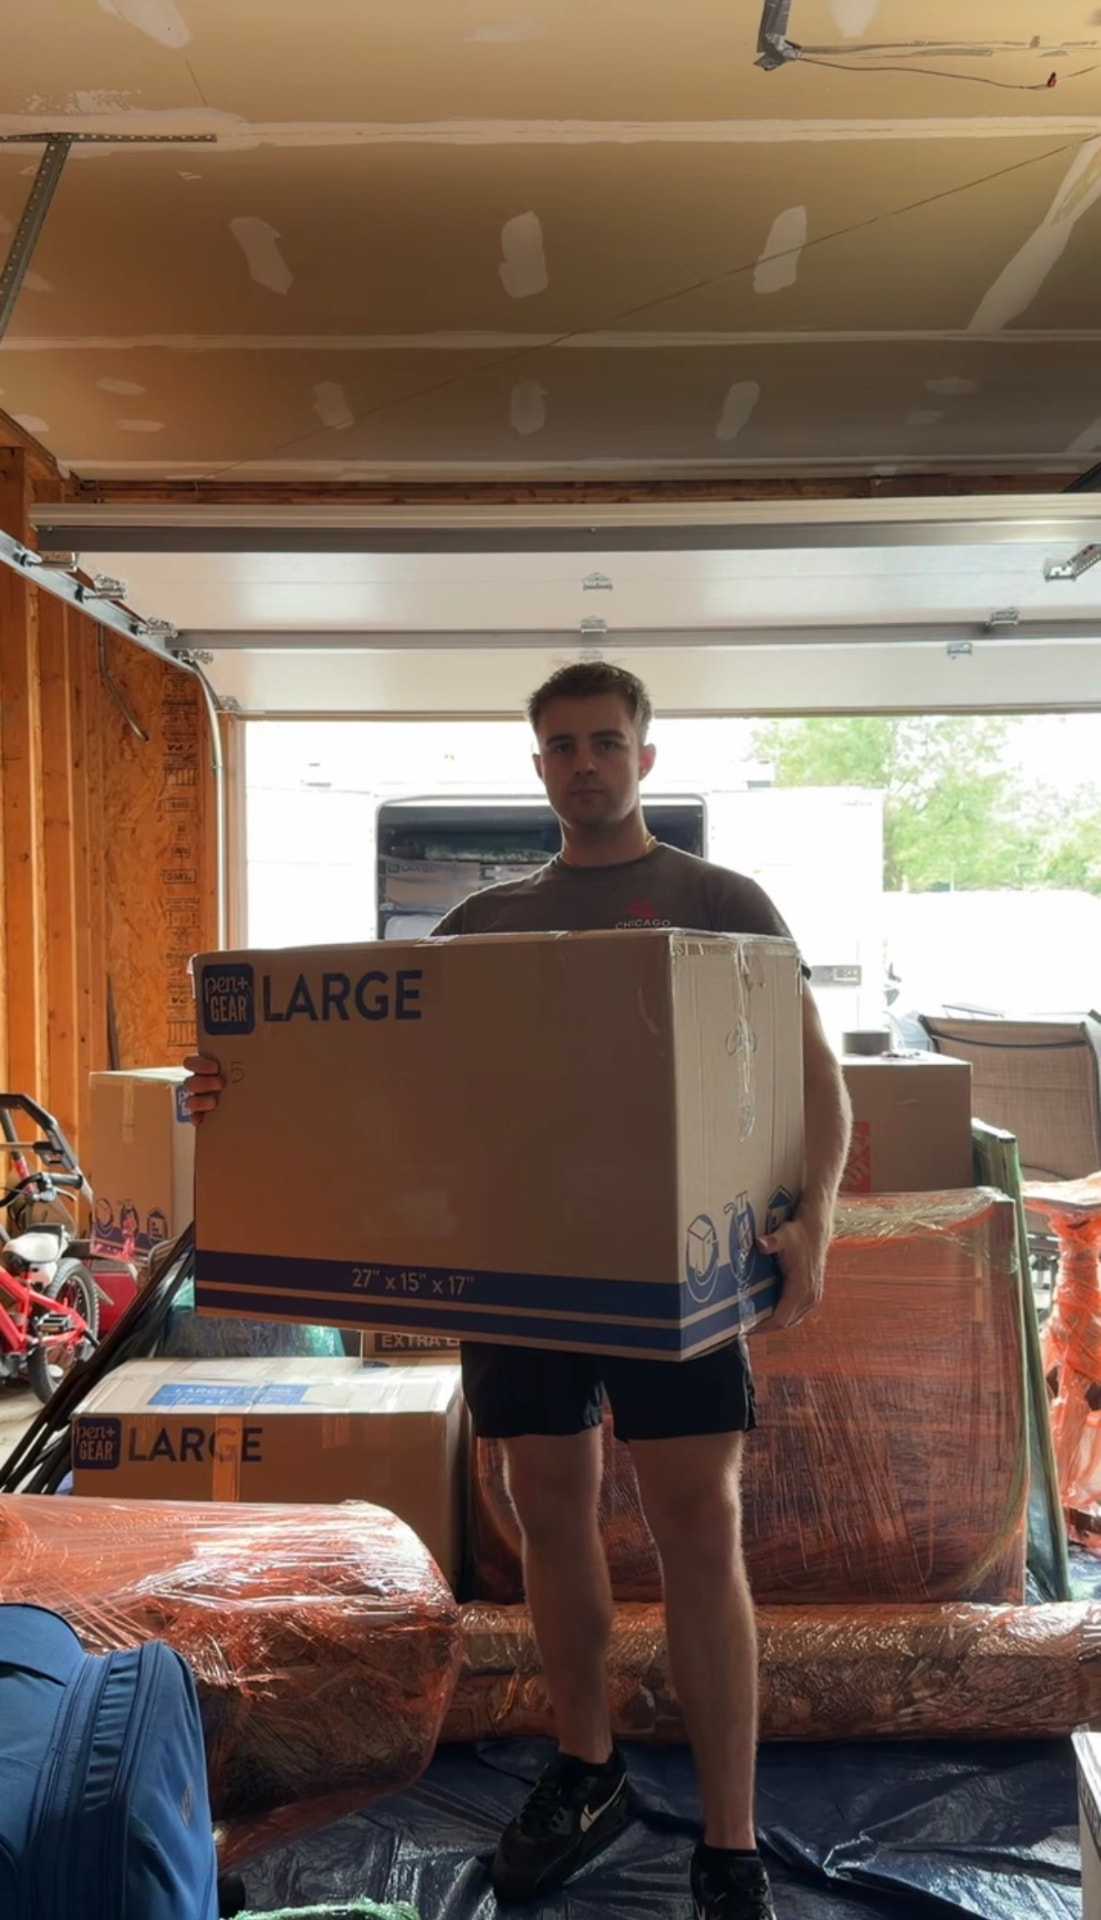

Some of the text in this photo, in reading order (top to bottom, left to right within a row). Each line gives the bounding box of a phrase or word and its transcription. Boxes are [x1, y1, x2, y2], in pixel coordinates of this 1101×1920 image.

[615, 918, 672, 930] CHICAGO
[204, 976, 249, 1003] pen+
[262, 969, 423, 1022] LARGE
[210, 995, 247, 1022] GEAR
[351, 1267, 475, 1297] 27" x 15" x 17"
[381, 1333, 441, 1349] EXTRA
[75, 1424, 116, 1445] pen+
[128, 1427, 263, 1462] LARGE
[79, 1440, 114, 1461] GEAR
